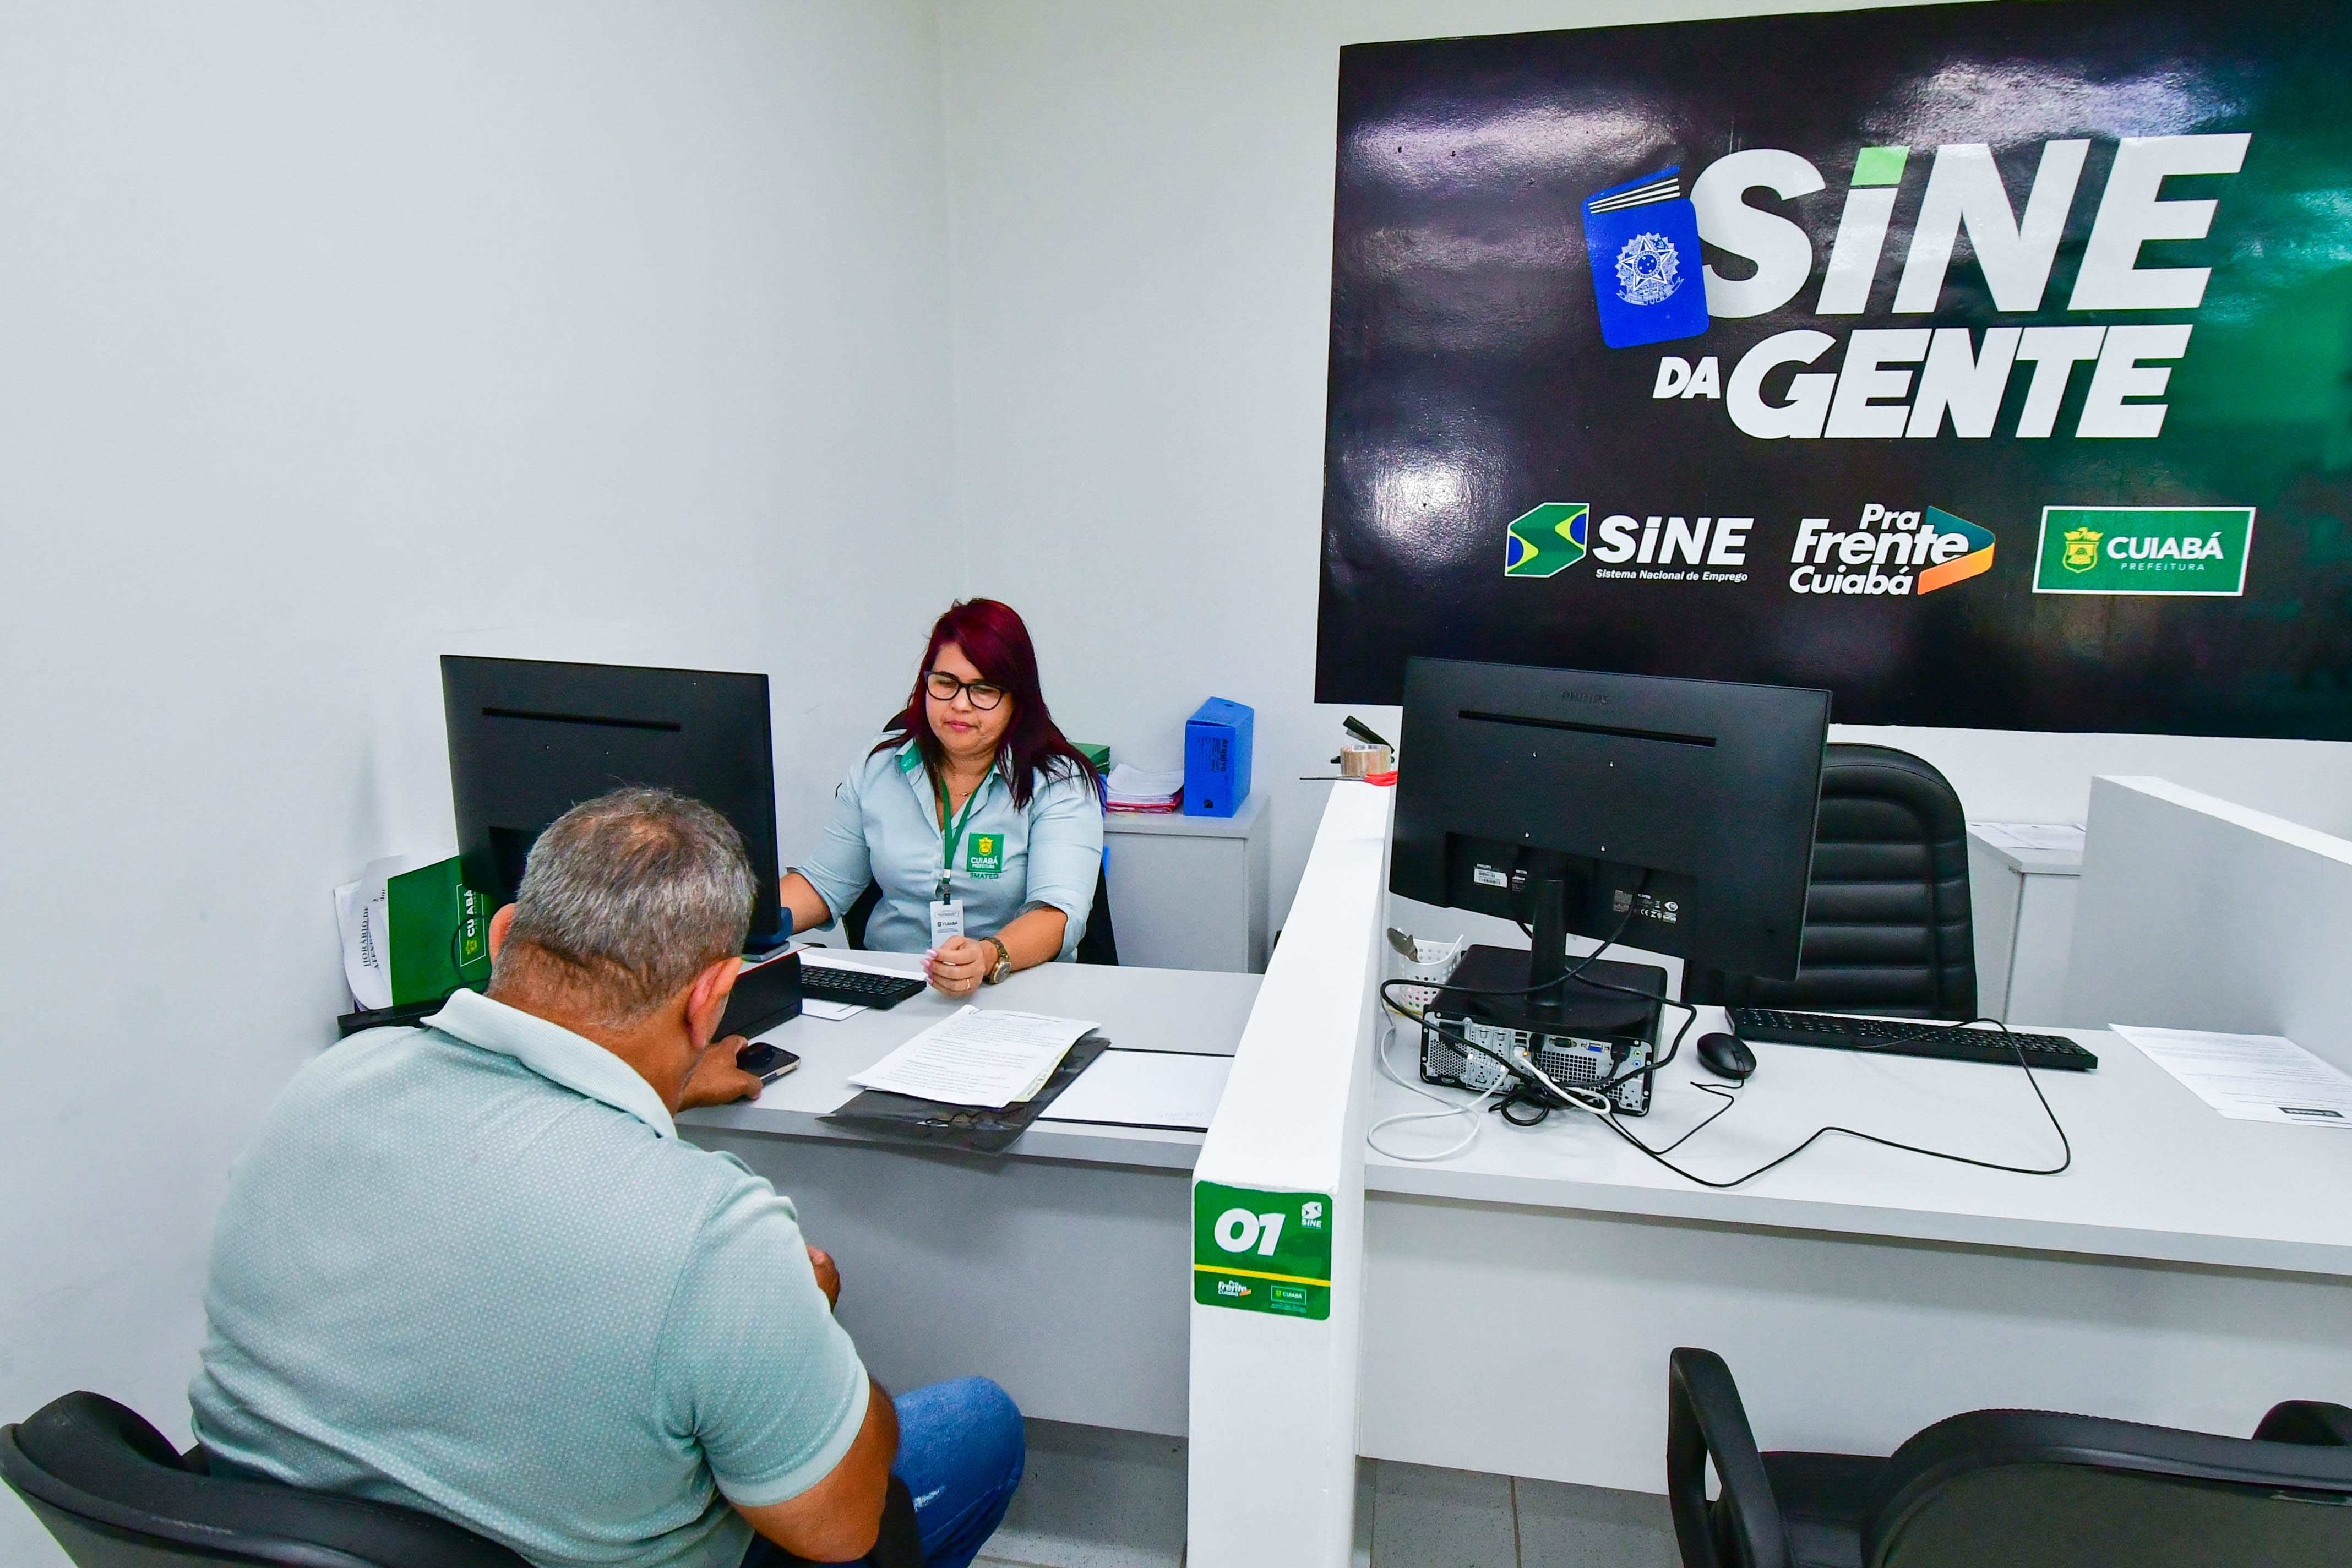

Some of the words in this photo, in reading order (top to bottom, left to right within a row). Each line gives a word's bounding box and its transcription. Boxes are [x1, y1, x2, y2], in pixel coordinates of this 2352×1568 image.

[1652, 355, 1721, 399] DA
[1726, 324, 2193, 439] GENTE
[1859, 503, 1921, 530] Pra
[1790, 519, 1969, 565] Frente
[2106, 531, 2224, 559] CUIABÁ
[1596, 569, 1637, 579] Sistema
[1639, 570, 1685, 580] Nacional
[1686, 571, 1700, 581] de
[1702, 571, 1749, 583] Emprego
[1789, 564, 1913, 596] Cuiabá
[971, 856, 998, 865] CUIABÁ
[464, 890, 475, 937] CUABÁ
[1214, 1208, 1286, 1256] 01
